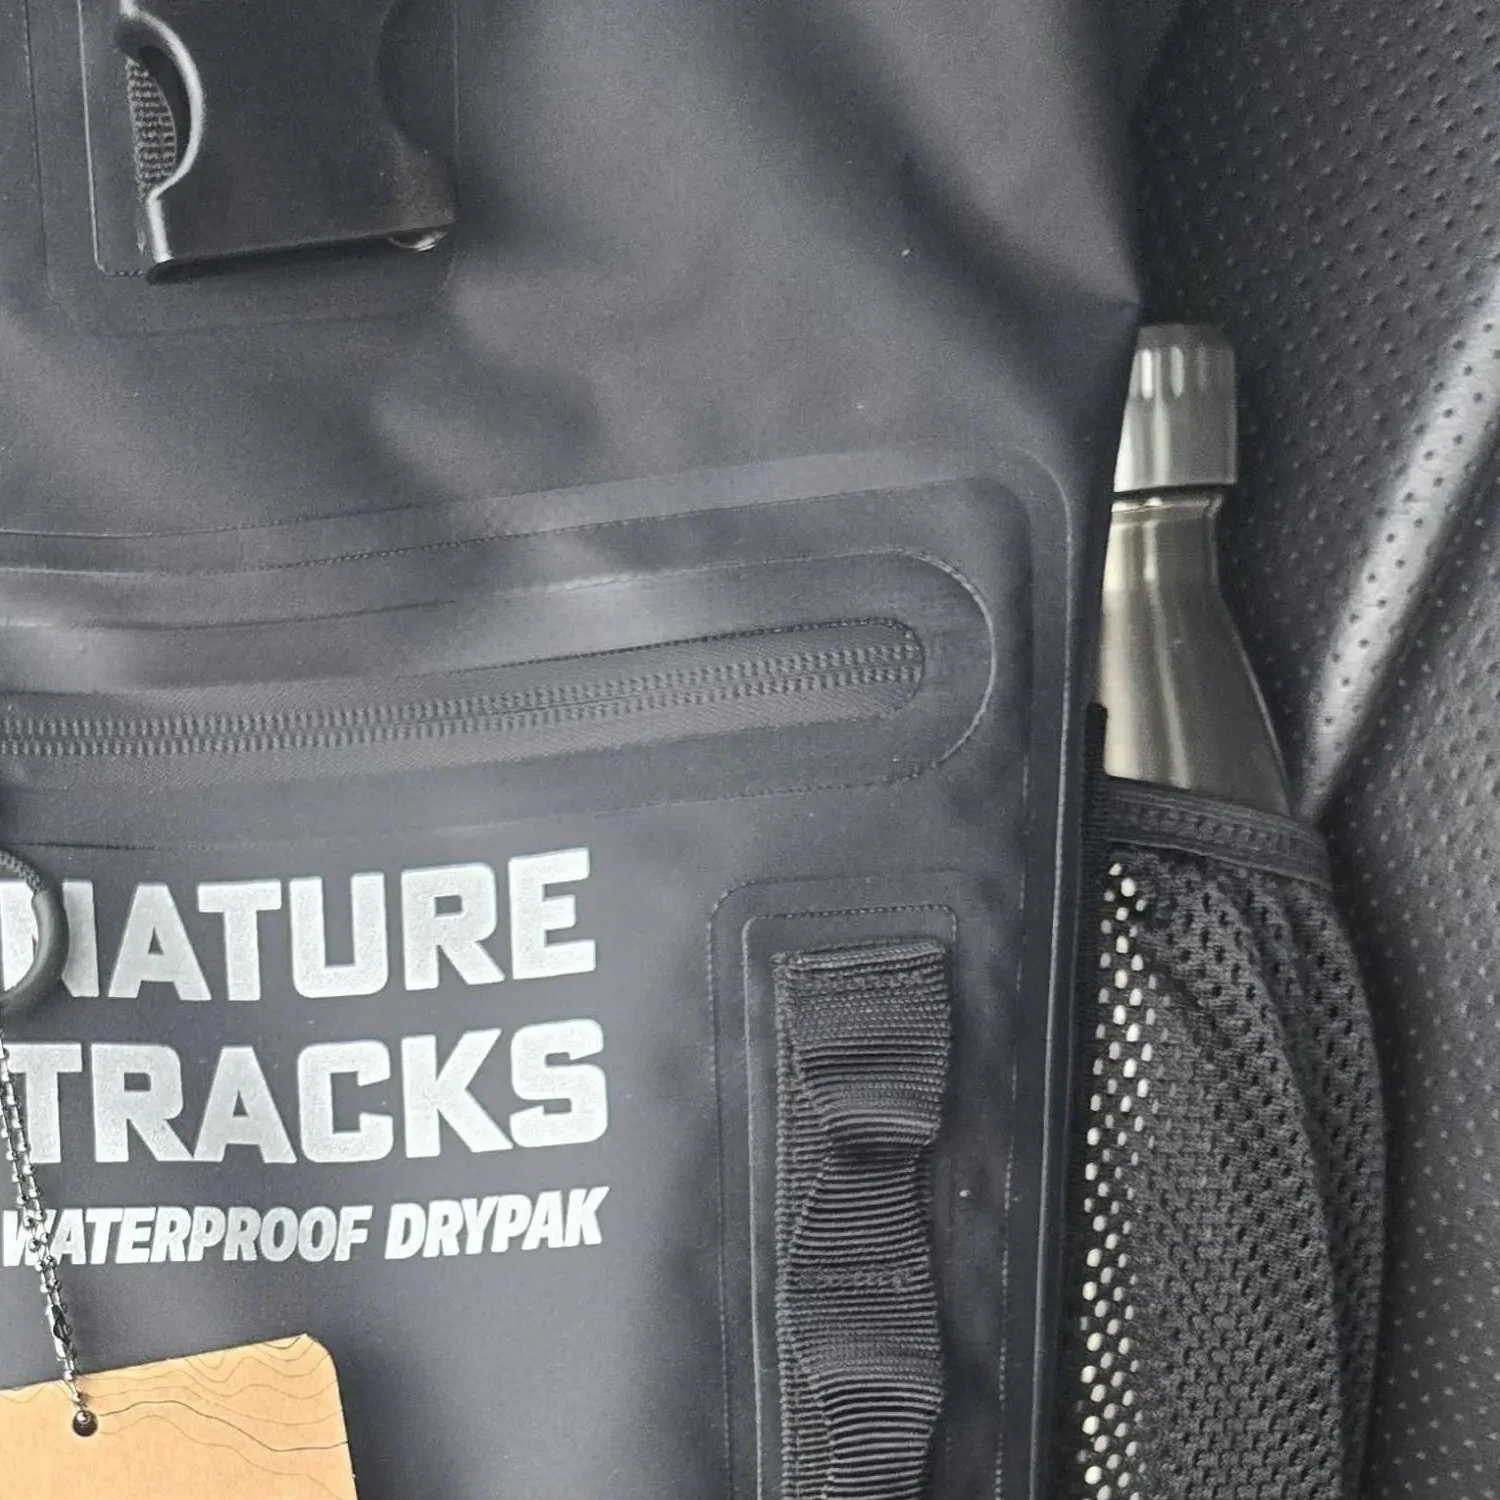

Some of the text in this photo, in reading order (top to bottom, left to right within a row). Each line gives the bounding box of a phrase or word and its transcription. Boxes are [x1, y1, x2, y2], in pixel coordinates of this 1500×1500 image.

[1, 1018, 608, 1166] TRACKS
[2, 1186, 610, 1267] WATERPROOF DRYPAK
